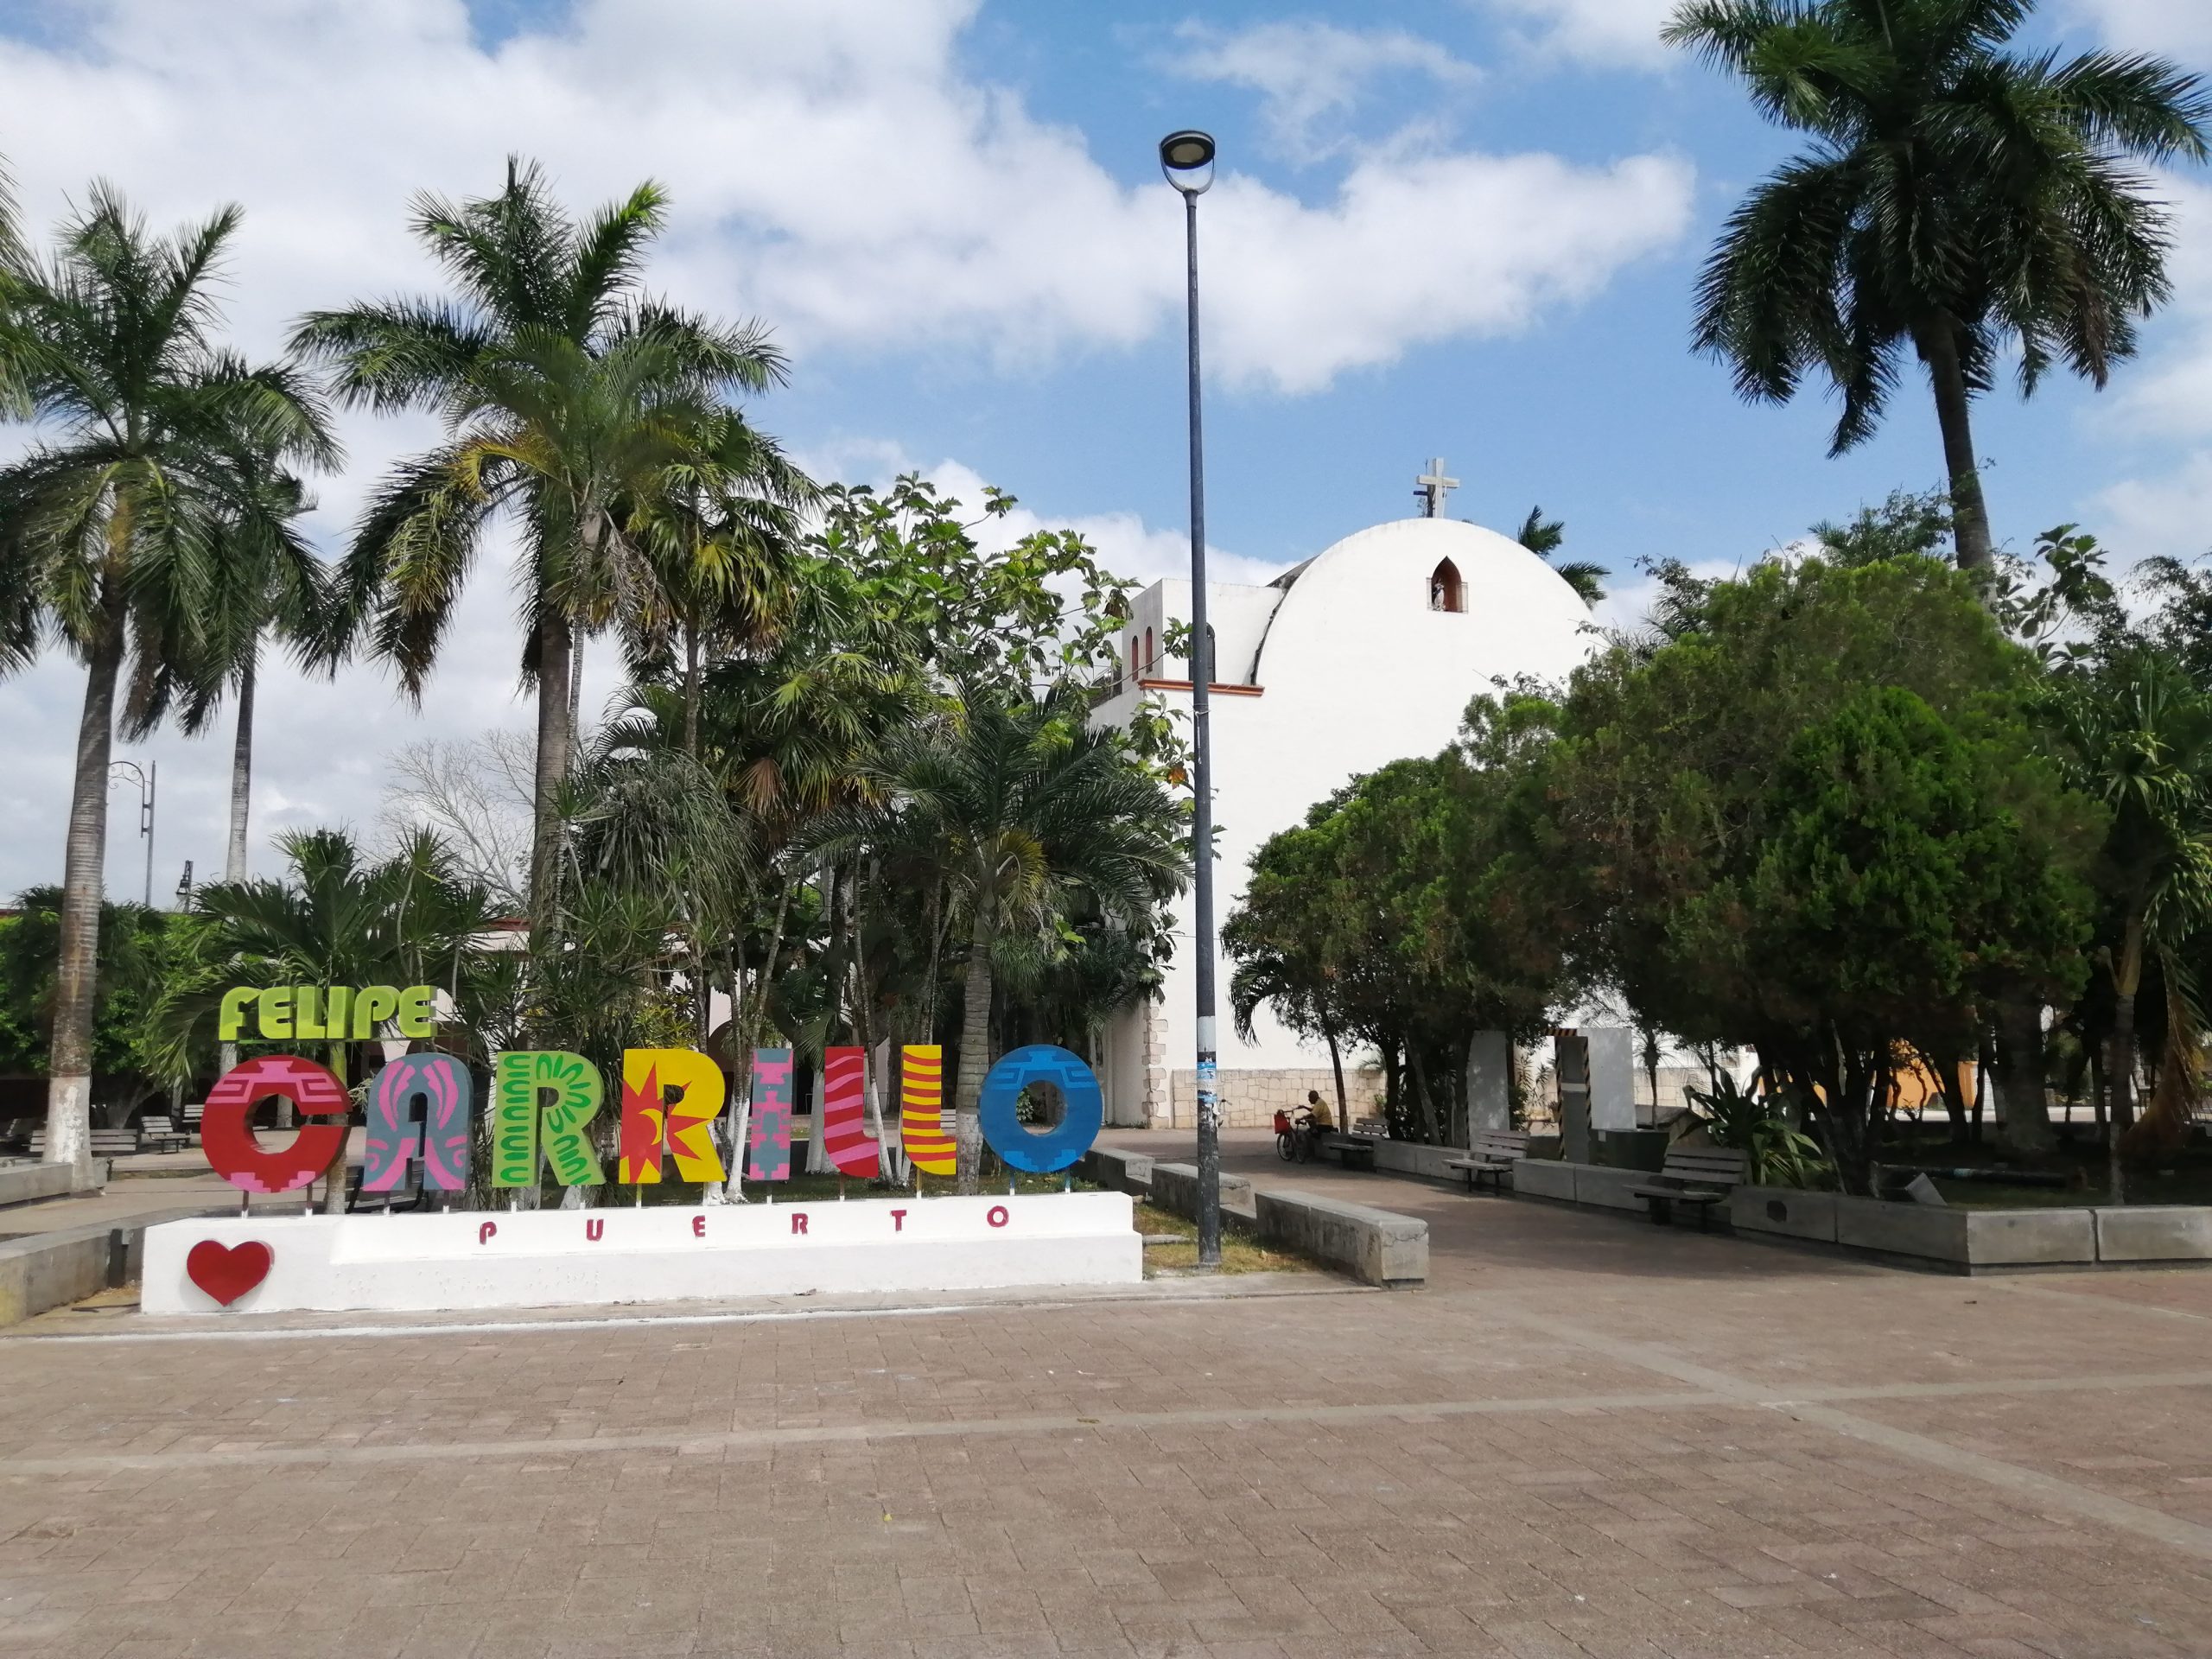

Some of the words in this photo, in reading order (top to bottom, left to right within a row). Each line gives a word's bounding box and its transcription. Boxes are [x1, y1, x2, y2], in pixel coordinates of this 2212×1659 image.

[219, 985, 438, 1040] FELIPE
[200, 1044, 1103, 1193] CARRILLO
[479, 1205, 1010, 1245] PUERTO
